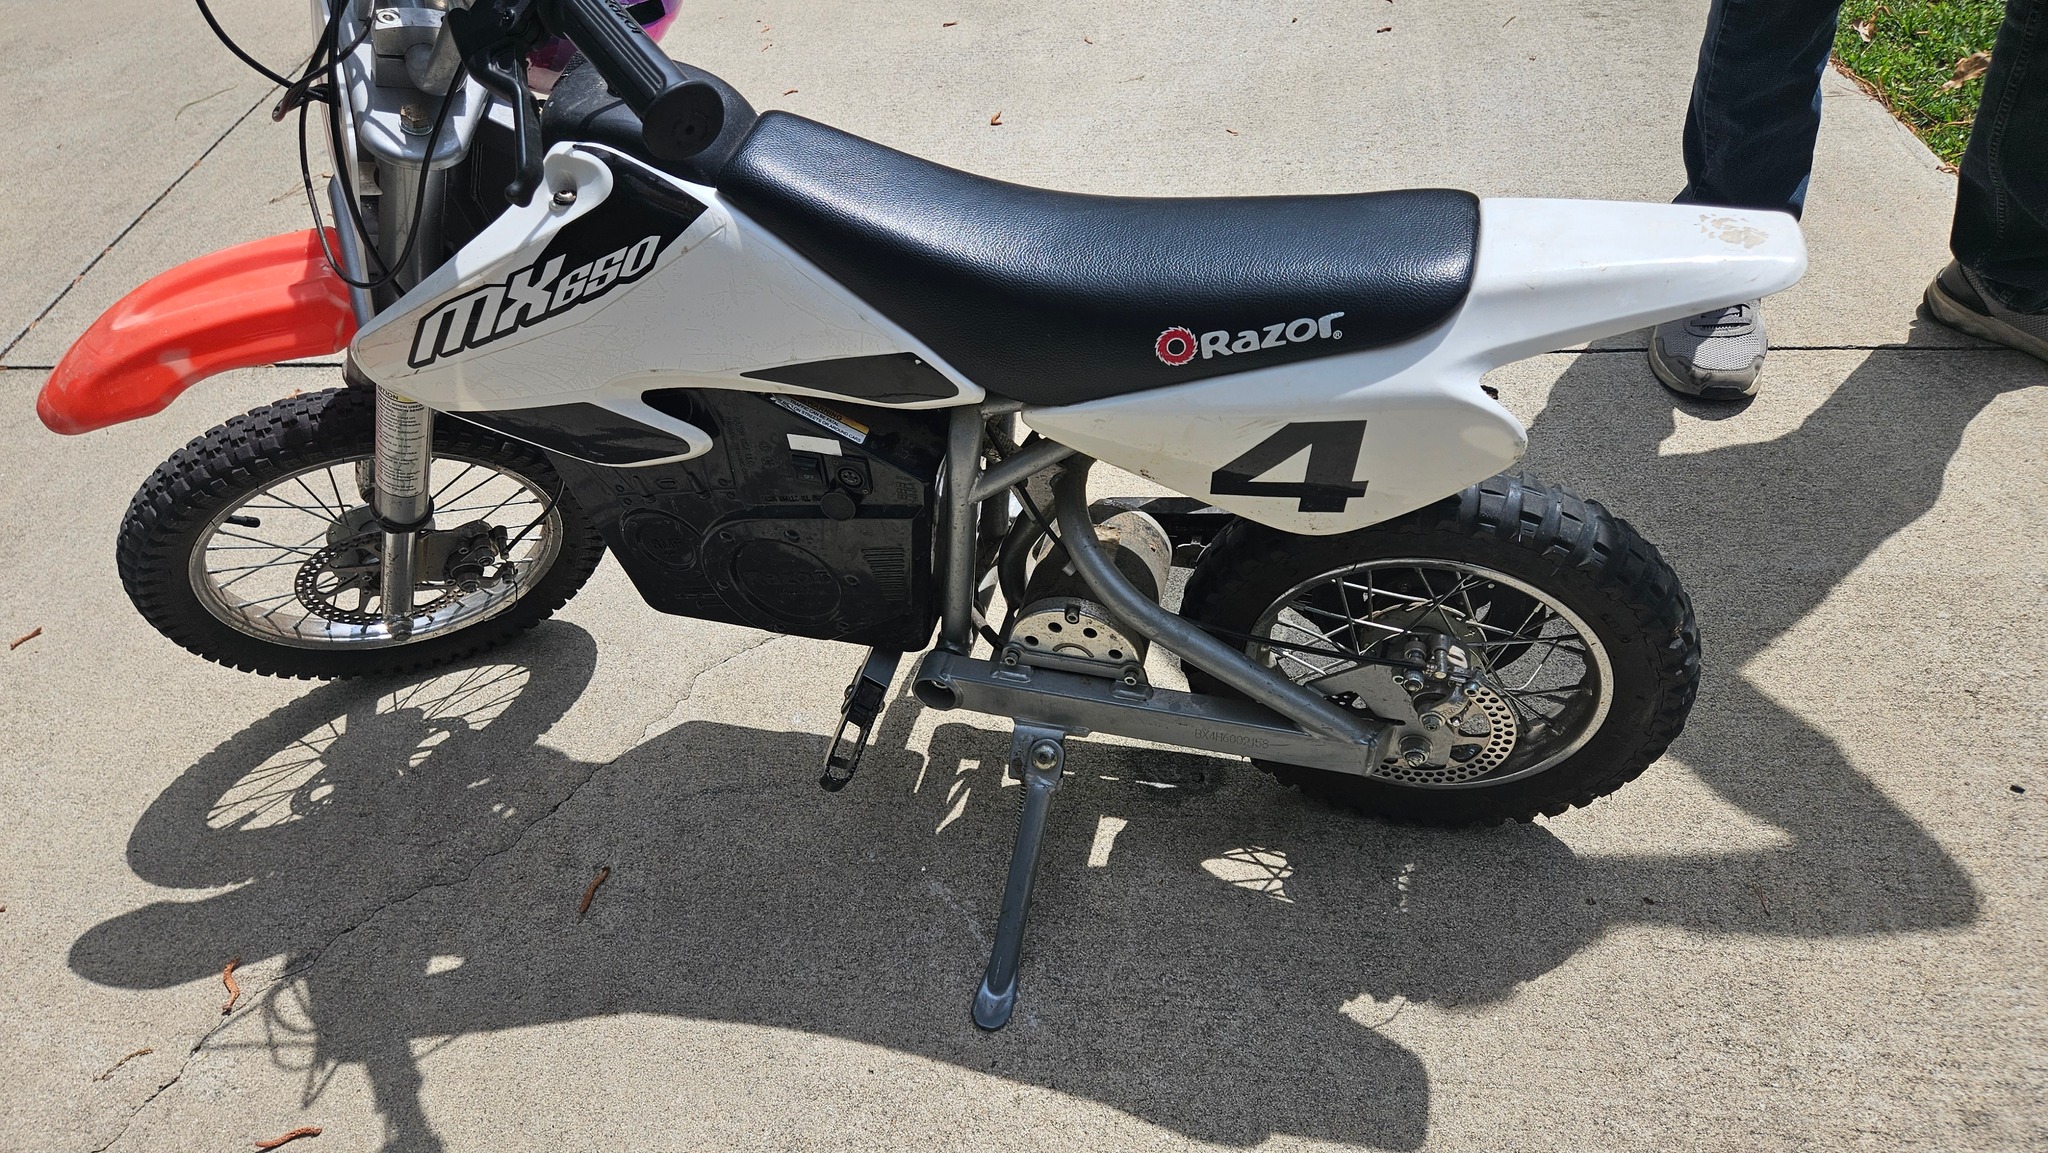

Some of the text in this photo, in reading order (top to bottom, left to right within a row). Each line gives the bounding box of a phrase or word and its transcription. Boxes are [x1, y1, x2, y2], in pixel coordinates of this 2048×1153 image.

[789, 399, 808, 411] TRAFFIC
[808, 408, 819, 416] CAN
[800, 409, 821, 422] STREETS
[806, 399, 843, 421] WARNING
[1210, 419, 1369, 512] 4
